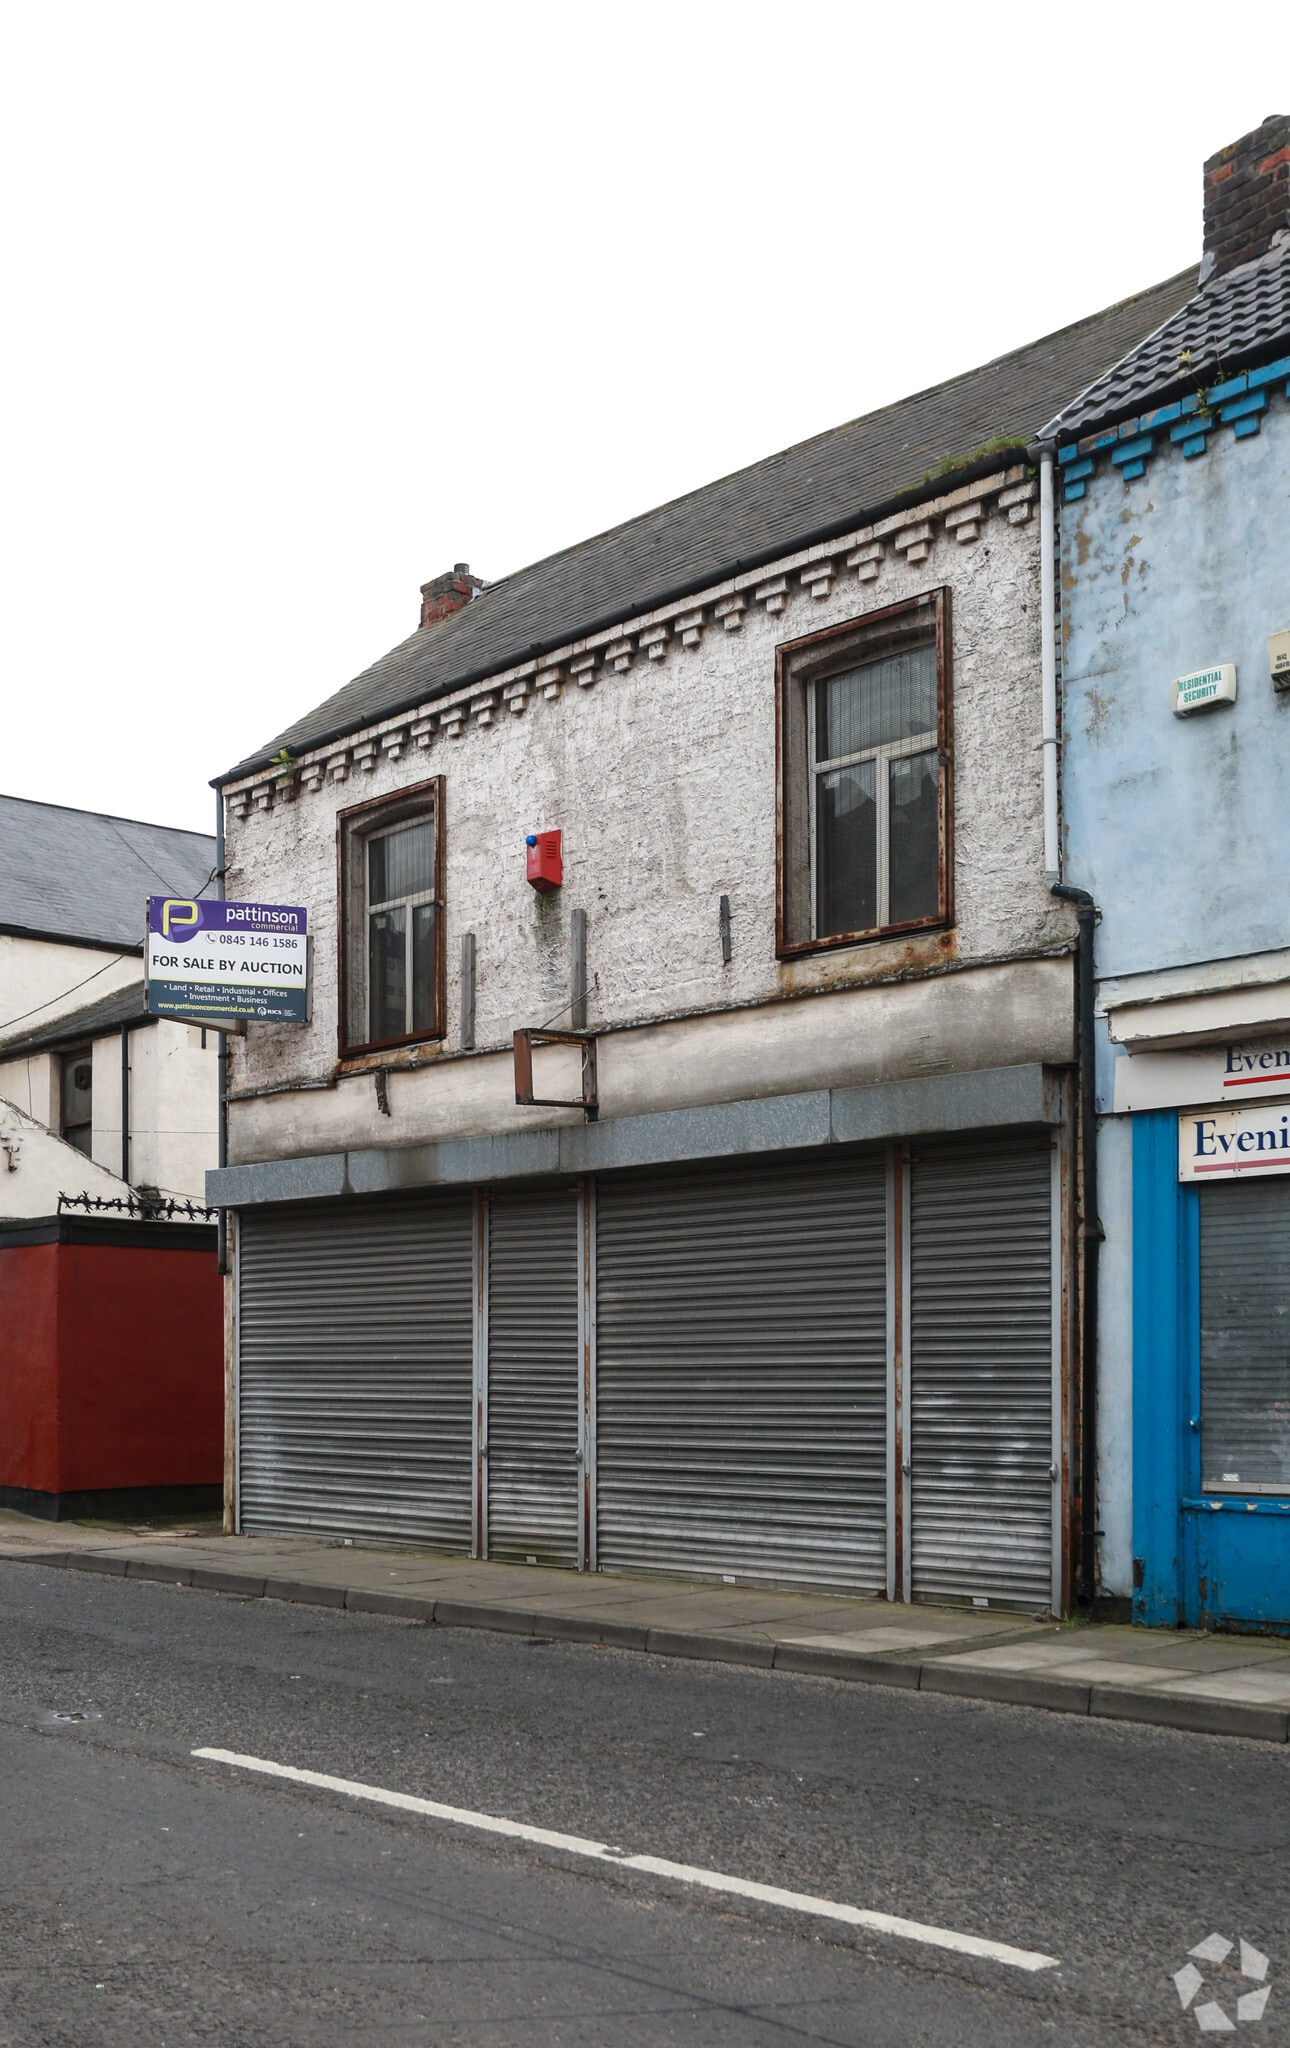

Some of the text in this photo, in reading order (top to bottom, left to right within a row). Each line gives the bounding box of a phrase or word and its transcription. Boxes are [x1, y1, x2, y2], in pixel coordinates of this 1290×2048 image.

[1178, 670, 1223, 691] RESIDENTIAL
[1183, 684, 1217, 703] SECURITY
[226, 907, 298, 924] pattinson
[251, 922, 298, 932] commercial
[219, 934, 298, 949] 0845 146 1586
[152, 955, 303, 975] FOR SALE BY AUCTION
[169, 984, 288, 997] Land Retail Industrial Offices
[189, 994, 268, 1004] Investment Business
[158, 1002, 255, 1014] www.pattinsoncommercial.co.uk
